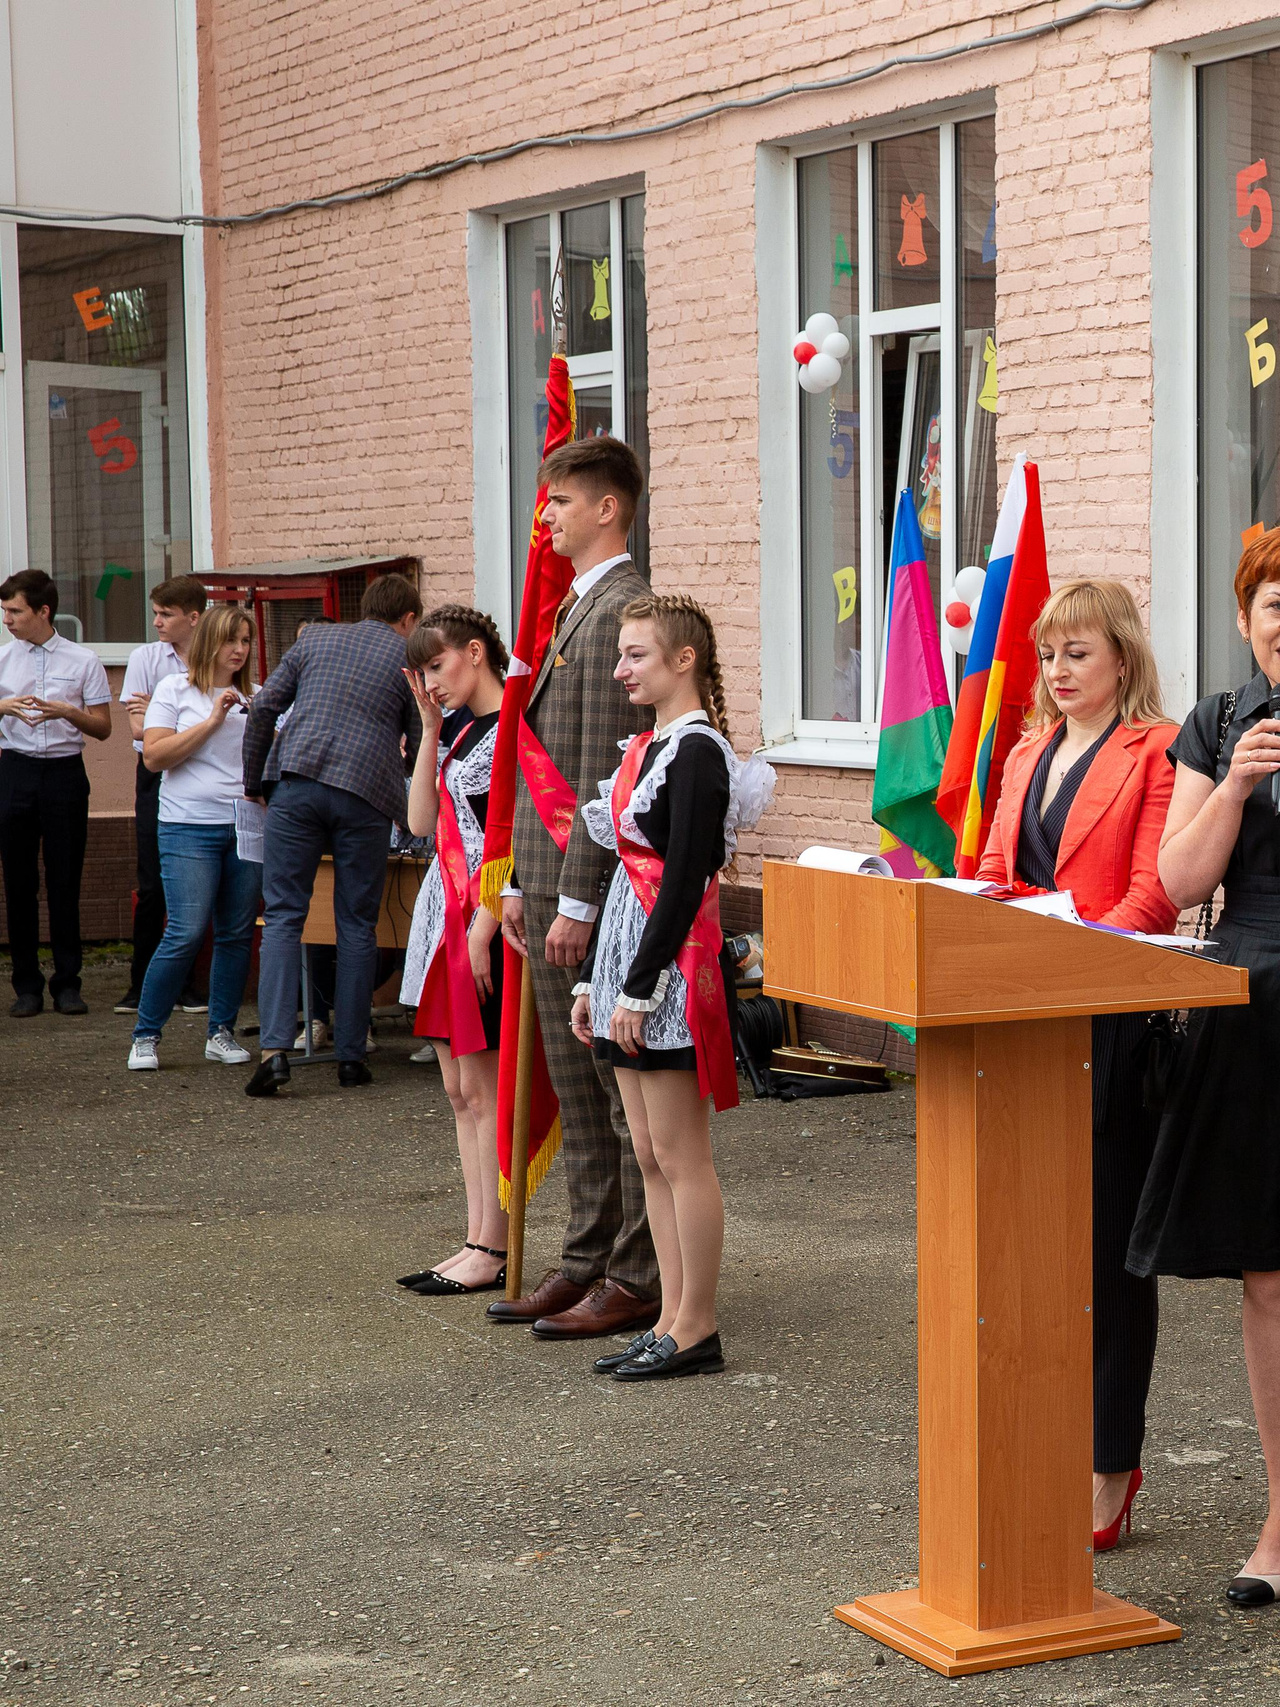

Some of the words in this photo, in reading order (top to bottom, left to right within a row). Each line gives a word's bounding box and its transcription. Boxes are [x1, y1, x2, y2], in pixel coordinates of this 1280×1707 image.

[1236, 158, 1273, 249] 5
[73, 286, 114, 331] Е
[1244, 317, 1276, 388] Б
[87, 416, 138, 474] 5
[832, 566, 857, 624] В
